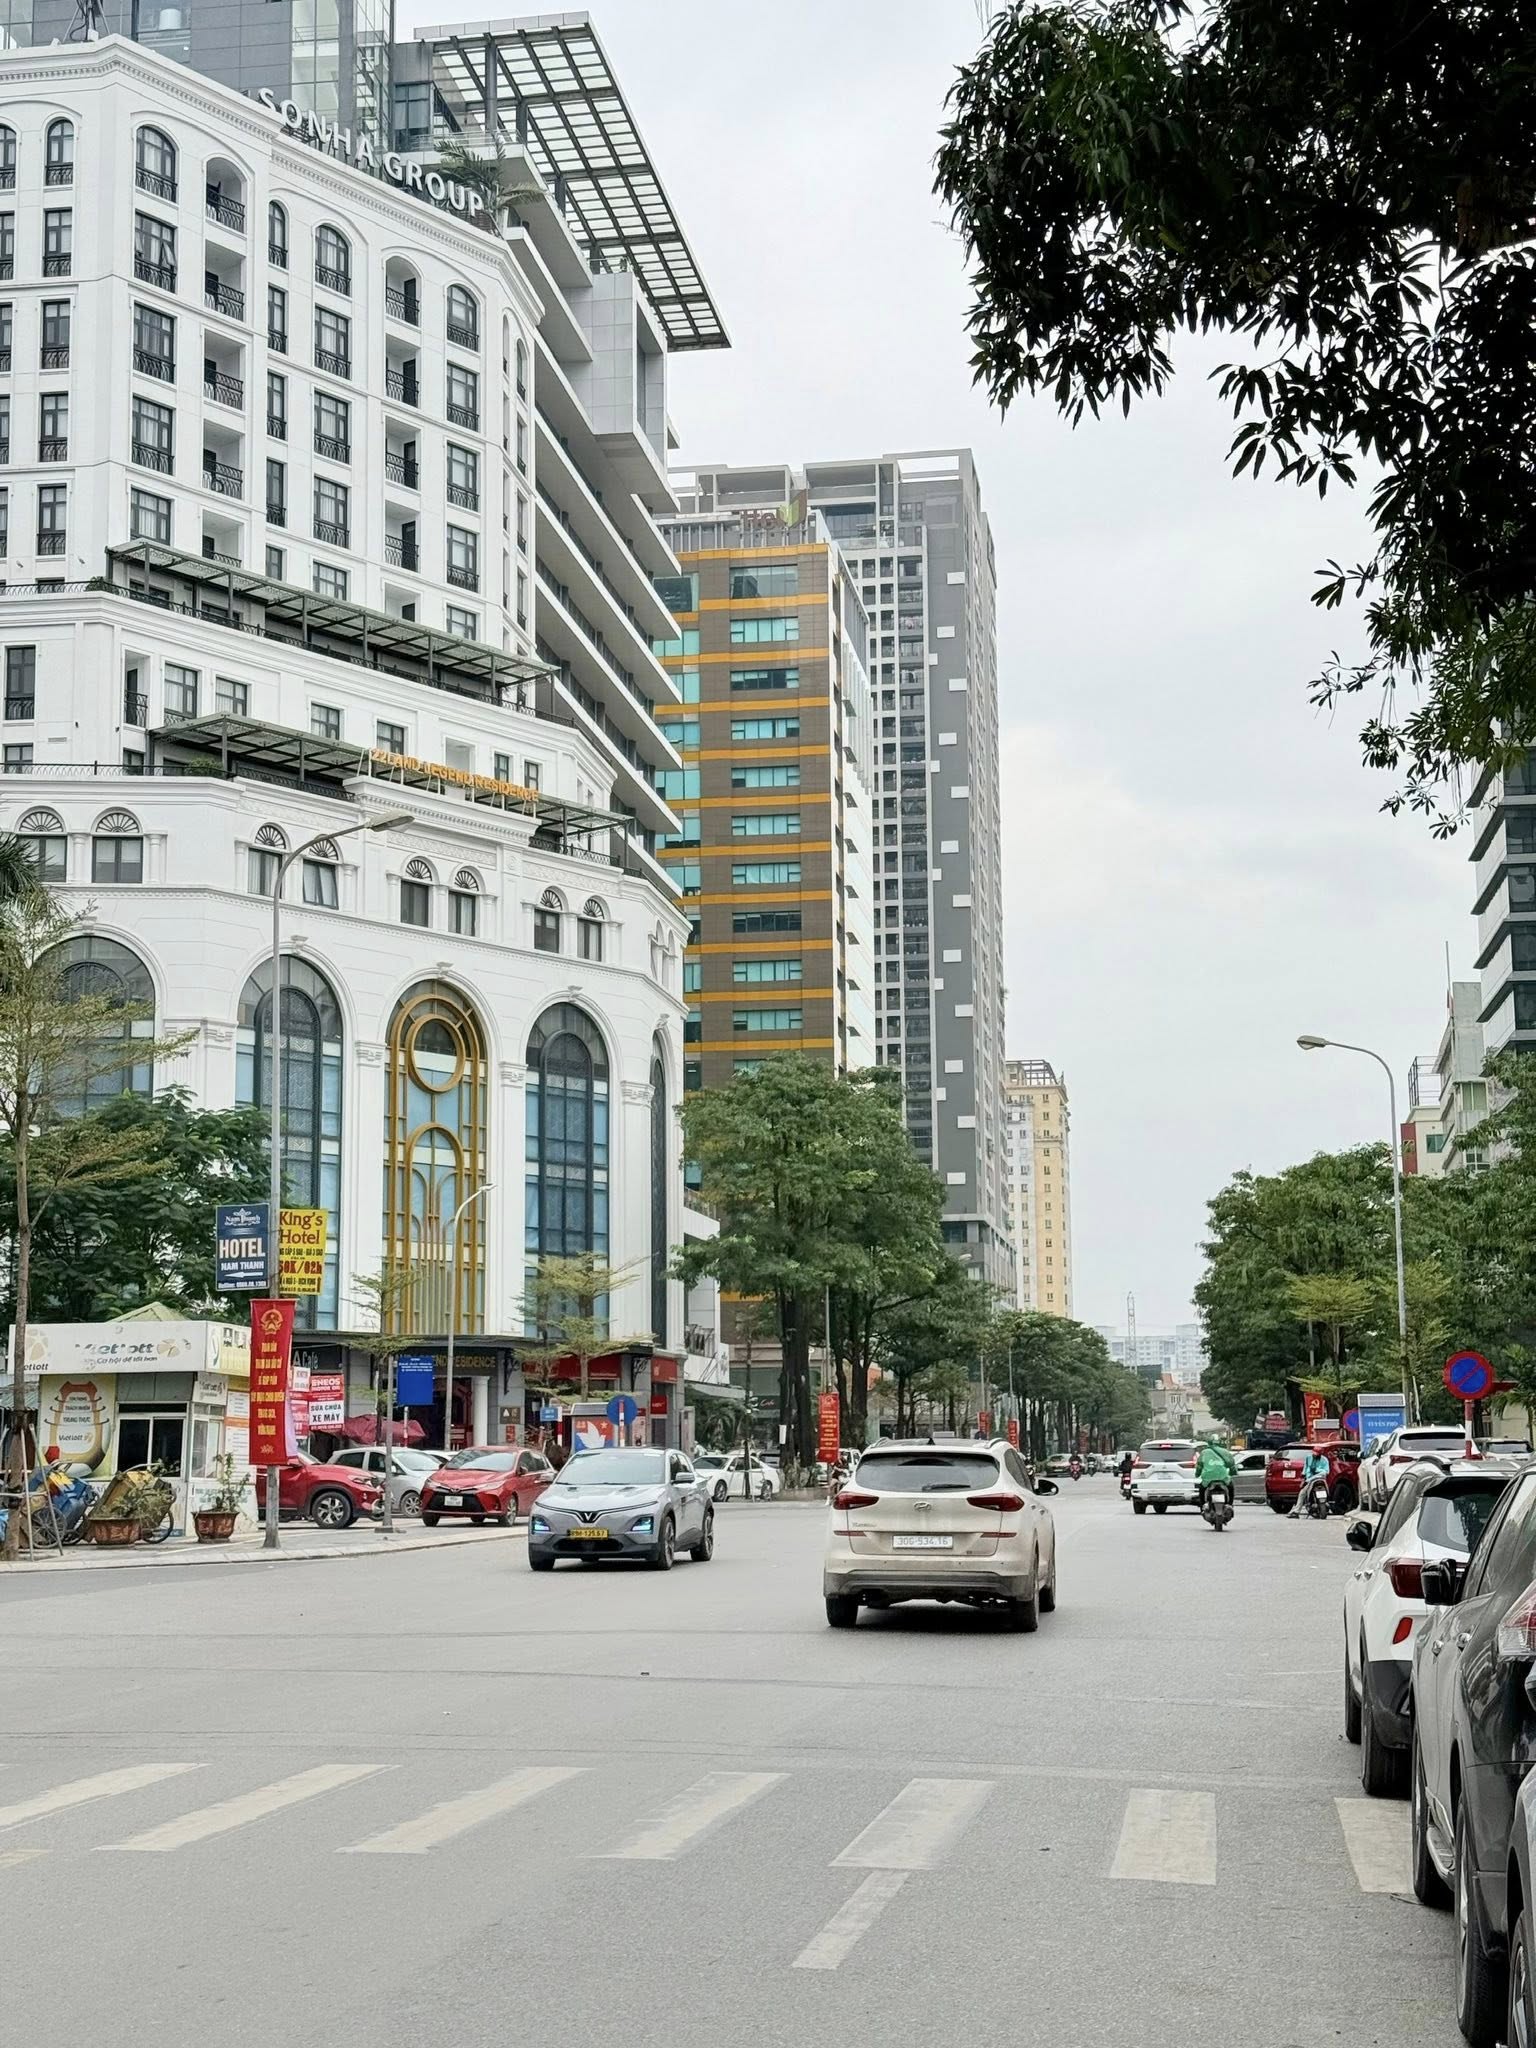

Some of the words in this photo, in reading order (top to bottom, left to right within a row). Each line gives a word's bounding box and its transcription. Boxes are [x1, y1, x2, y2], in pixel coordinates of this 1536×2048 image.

[383, 152, 484, 217] GROUP
[473, 774, 539, 803] RESIDENCE
[279, 1229, 320, 1245] Hotel
[219, 1237, 266, 1259] HOTEL
[221, 1262, 238, 1271] NAM
[240, 1261, 264, 1270] THANH
[313, 1414, 322, 1422] XE
